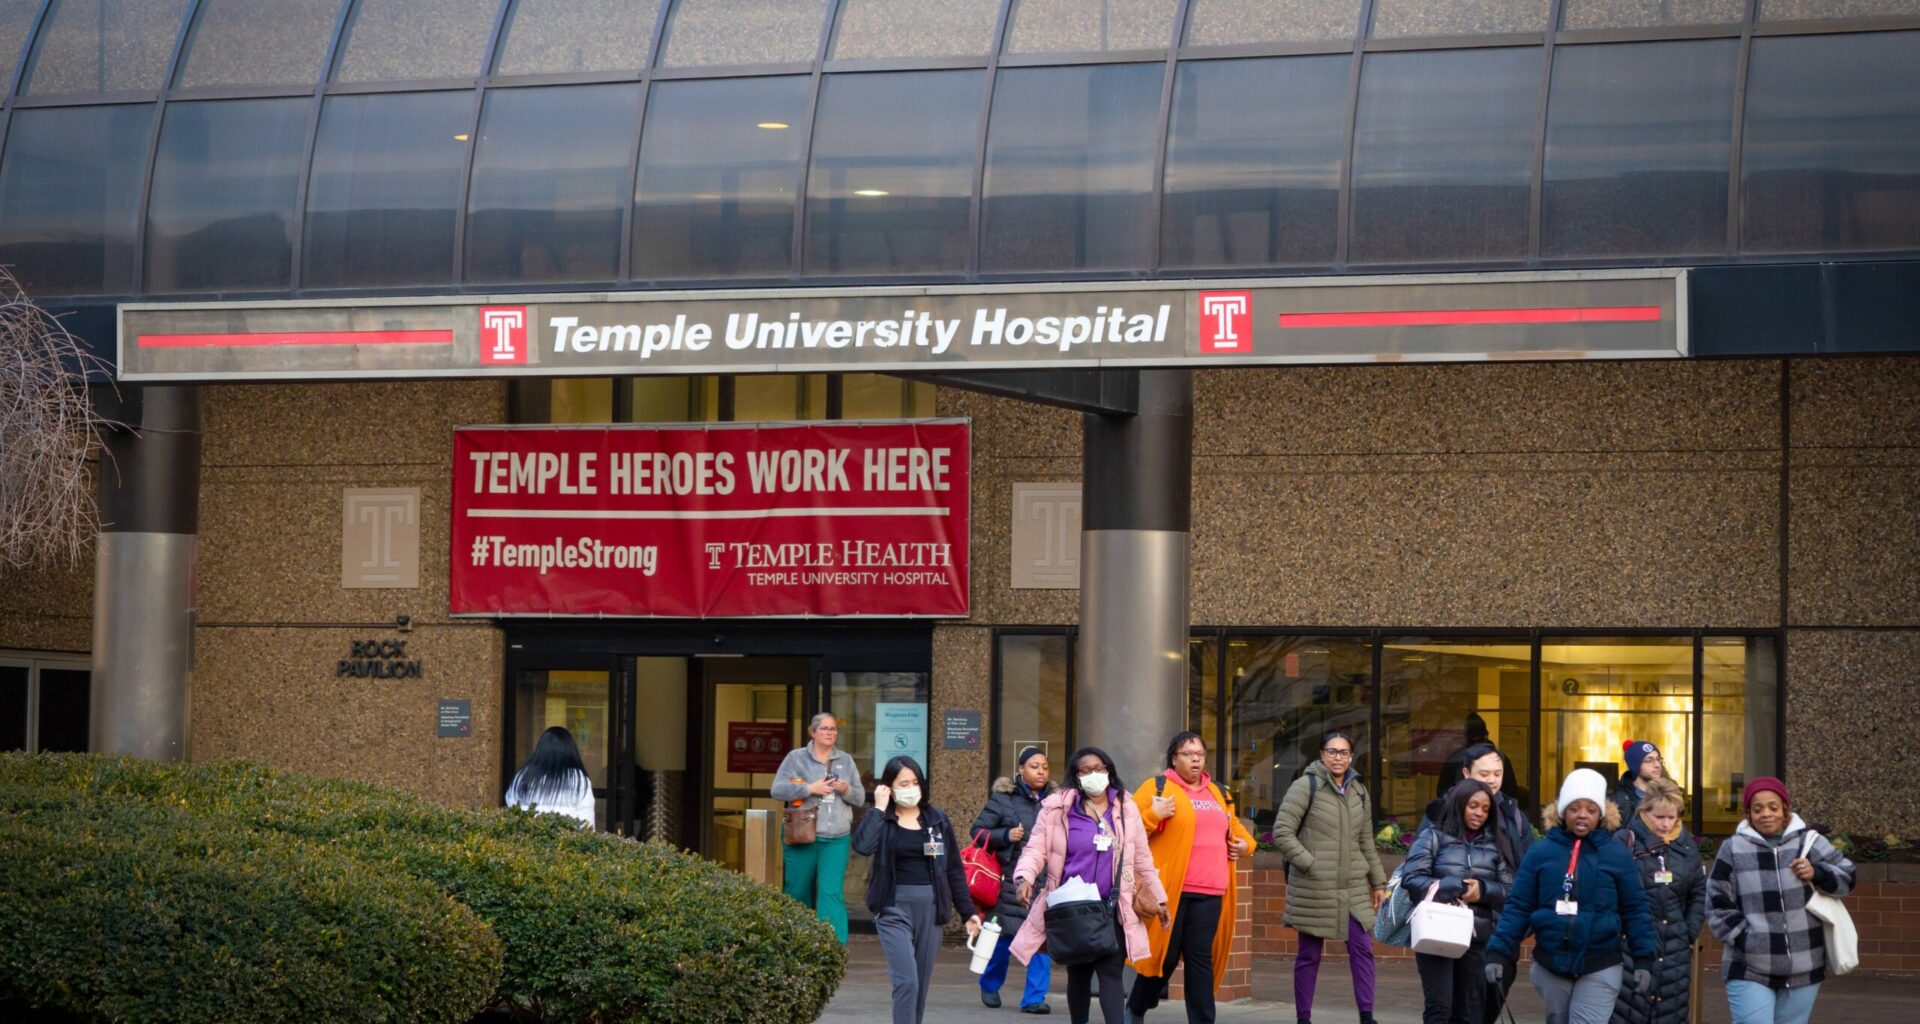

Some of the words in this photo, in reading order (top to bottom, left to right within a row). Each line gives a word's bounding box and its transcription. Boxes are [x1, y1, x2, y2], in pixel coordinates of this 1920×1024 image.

[550, 314, 713, 359] Temple
[725, 310, 960, 354] University
[970, 304, 1171, 352] Hospital
[470, 452, 597, 494] TEMPLE
[610, 451, 735, 495] HEROES
[747, 449, 850, 493] WORK
[863, 448, 950, 491] HERE
[471, 535, 658, 577] #TempleStrong
[729, 542, 834, 568] TEMPLE
[841, 540, 951, 567] HEALTH
[747, 572, 798, 586] TEMPLE
[802, 571, 879, 585] UNIVERSITY
[883, 571, 949, 585] HOSPITAL
[351, 640, 406, 658] ROCK
[337, 661, 422, 678] PAVILION
